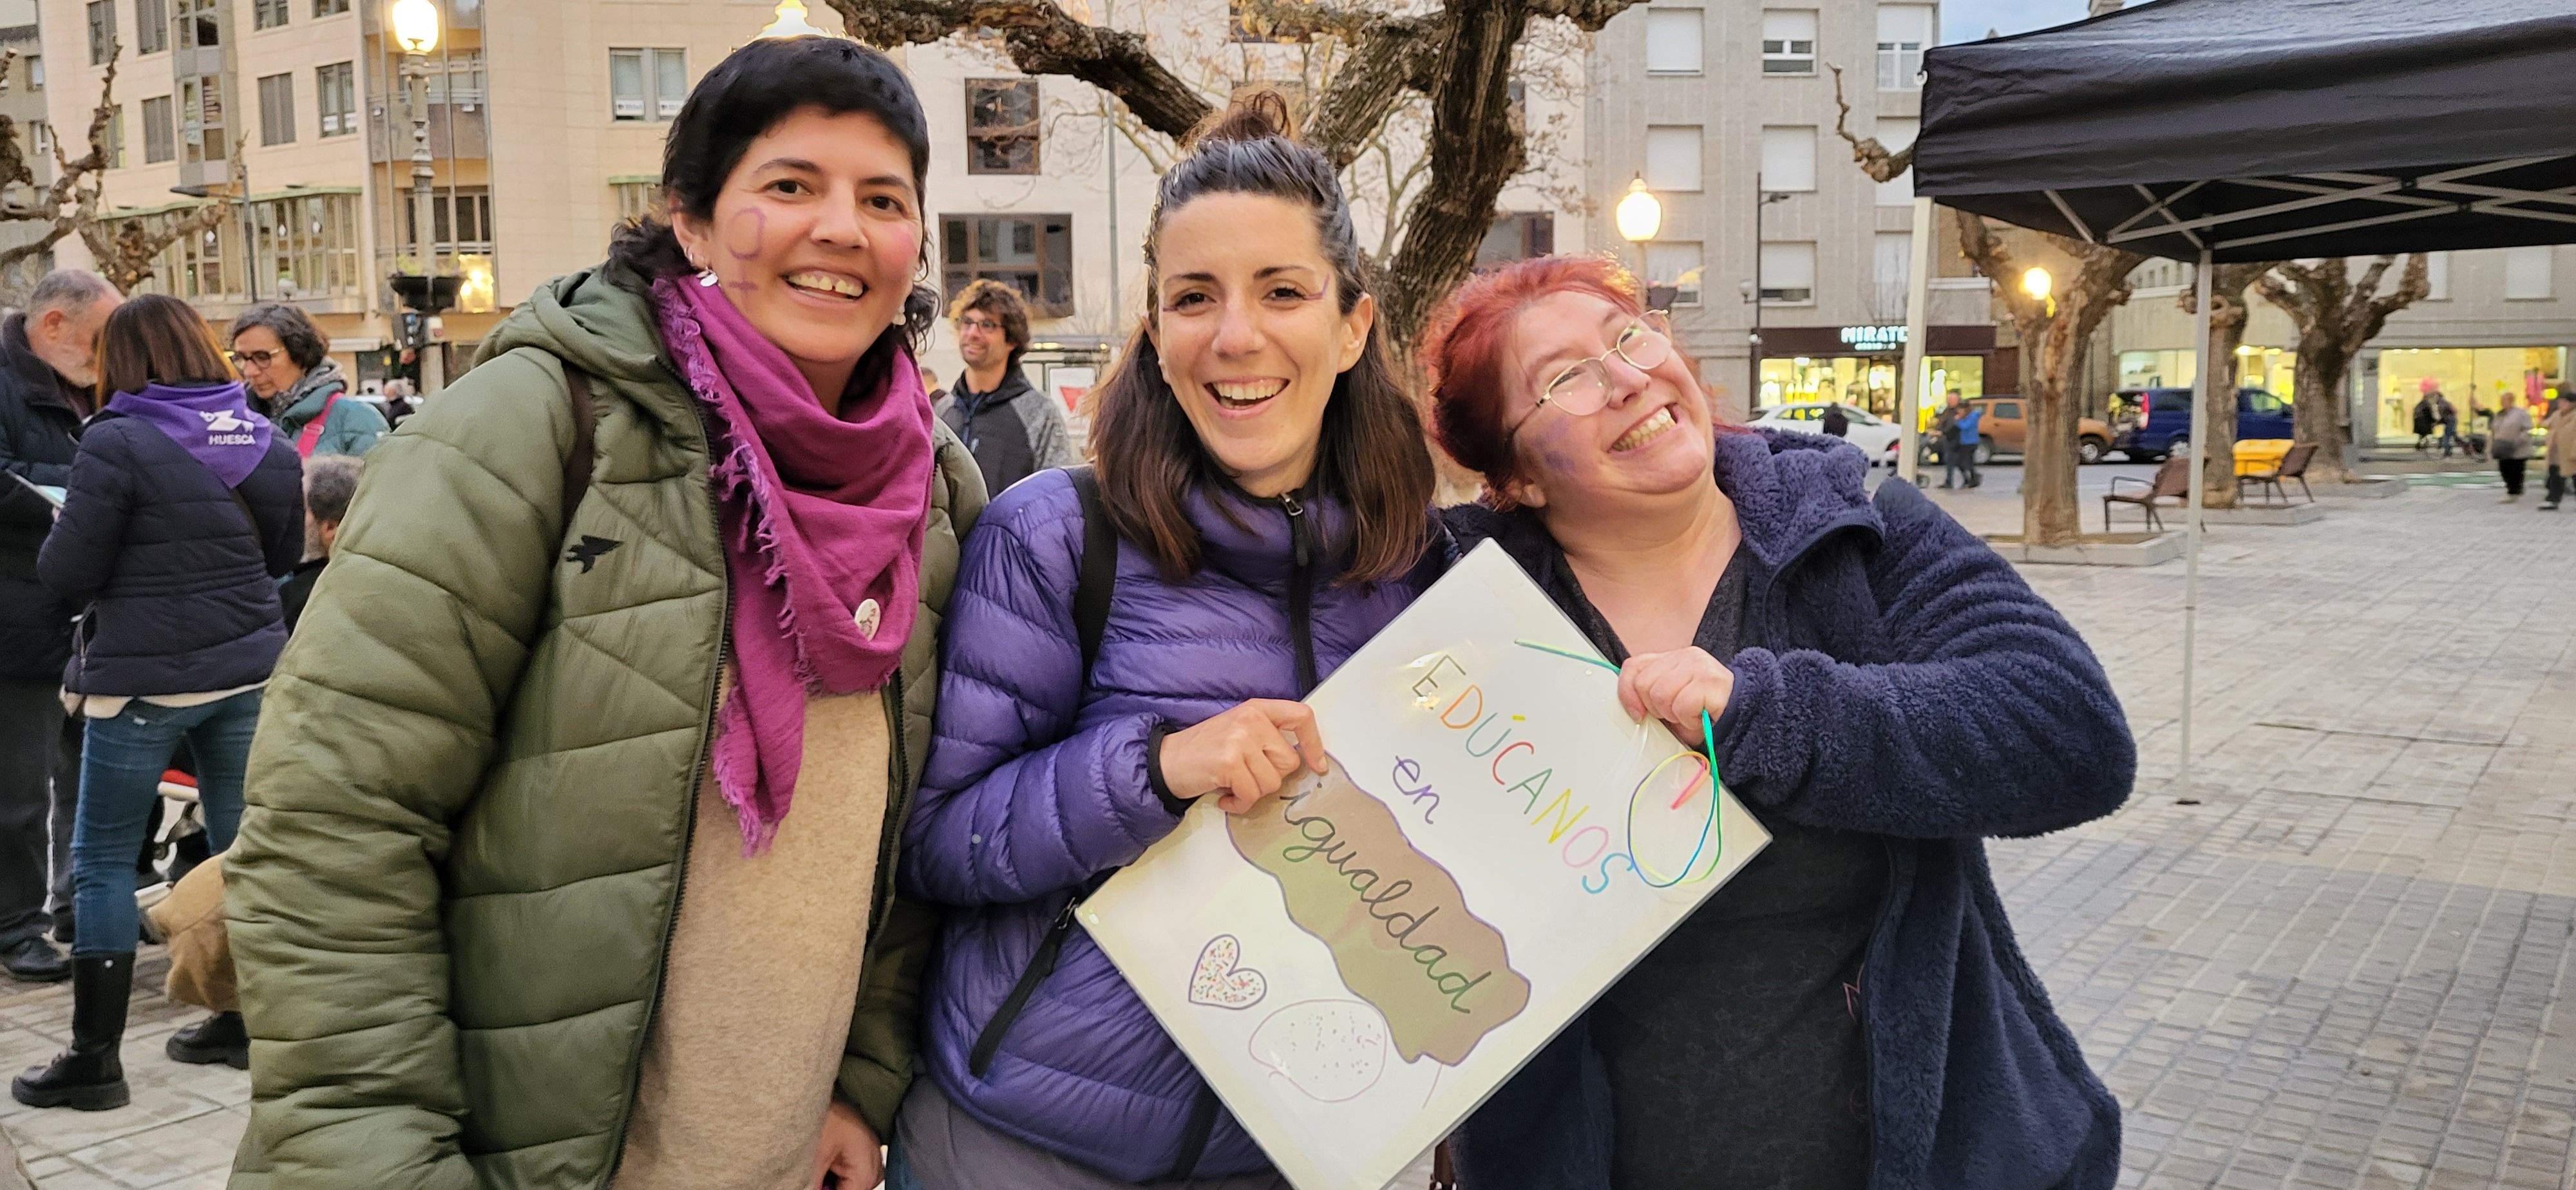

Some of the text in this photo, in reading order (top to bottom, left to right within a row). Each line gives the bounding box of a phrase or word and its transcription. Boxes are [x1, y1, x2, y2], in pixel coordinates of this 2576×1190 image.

[208, 434, 256, 446] HUESCA
[1392, 755, 1440, 824] en
[1280, 777, 1492, 1014] igualdad
